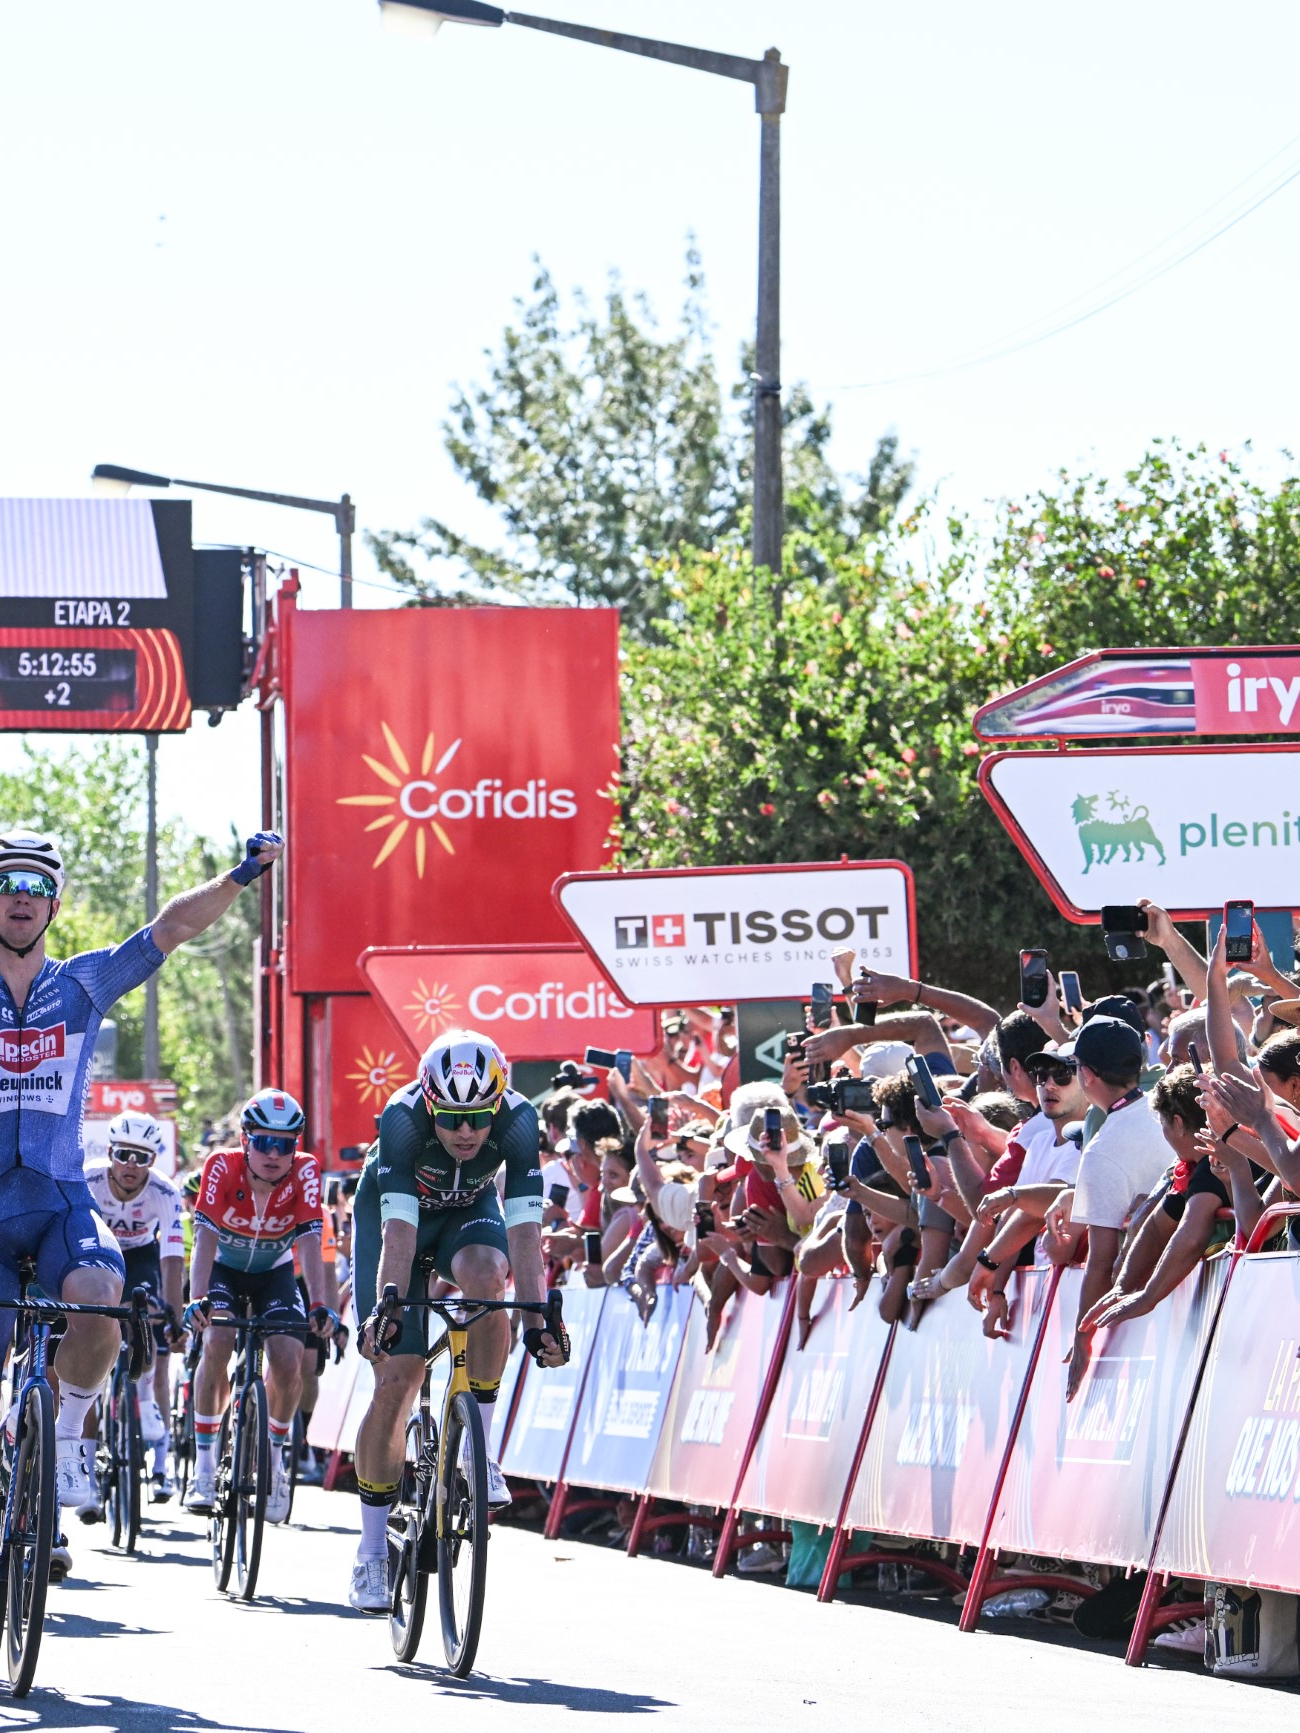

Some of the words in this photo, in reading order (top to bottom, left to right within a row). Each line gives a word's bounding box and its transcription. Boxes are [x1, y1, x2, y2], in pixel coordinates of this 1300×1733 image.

[54, 601, 113, 625] ETAPA
[117, 602, 131, 626] 2
[18, 653, 97, 677] 5:12:55
[44, 683, 71, 706] +2
[1100, 699, 1131, 715] iryo
[400, 779, 578, 820] Cofidis
[693, 906, 889, 946] TISSOT
[616, 955, 674, 969] SWISS
[686, 951, 773, 966] WATCHES
[784, 949, 828, 962] SINC
[859, 946, 893, 961] 853
[468, 981, 635, 1021] Cofidis
[101, 1085, 146, 1110] iryo
[205, 1155, 229, 1206] dstny
[218, 1232, 297, 1253] dstny
